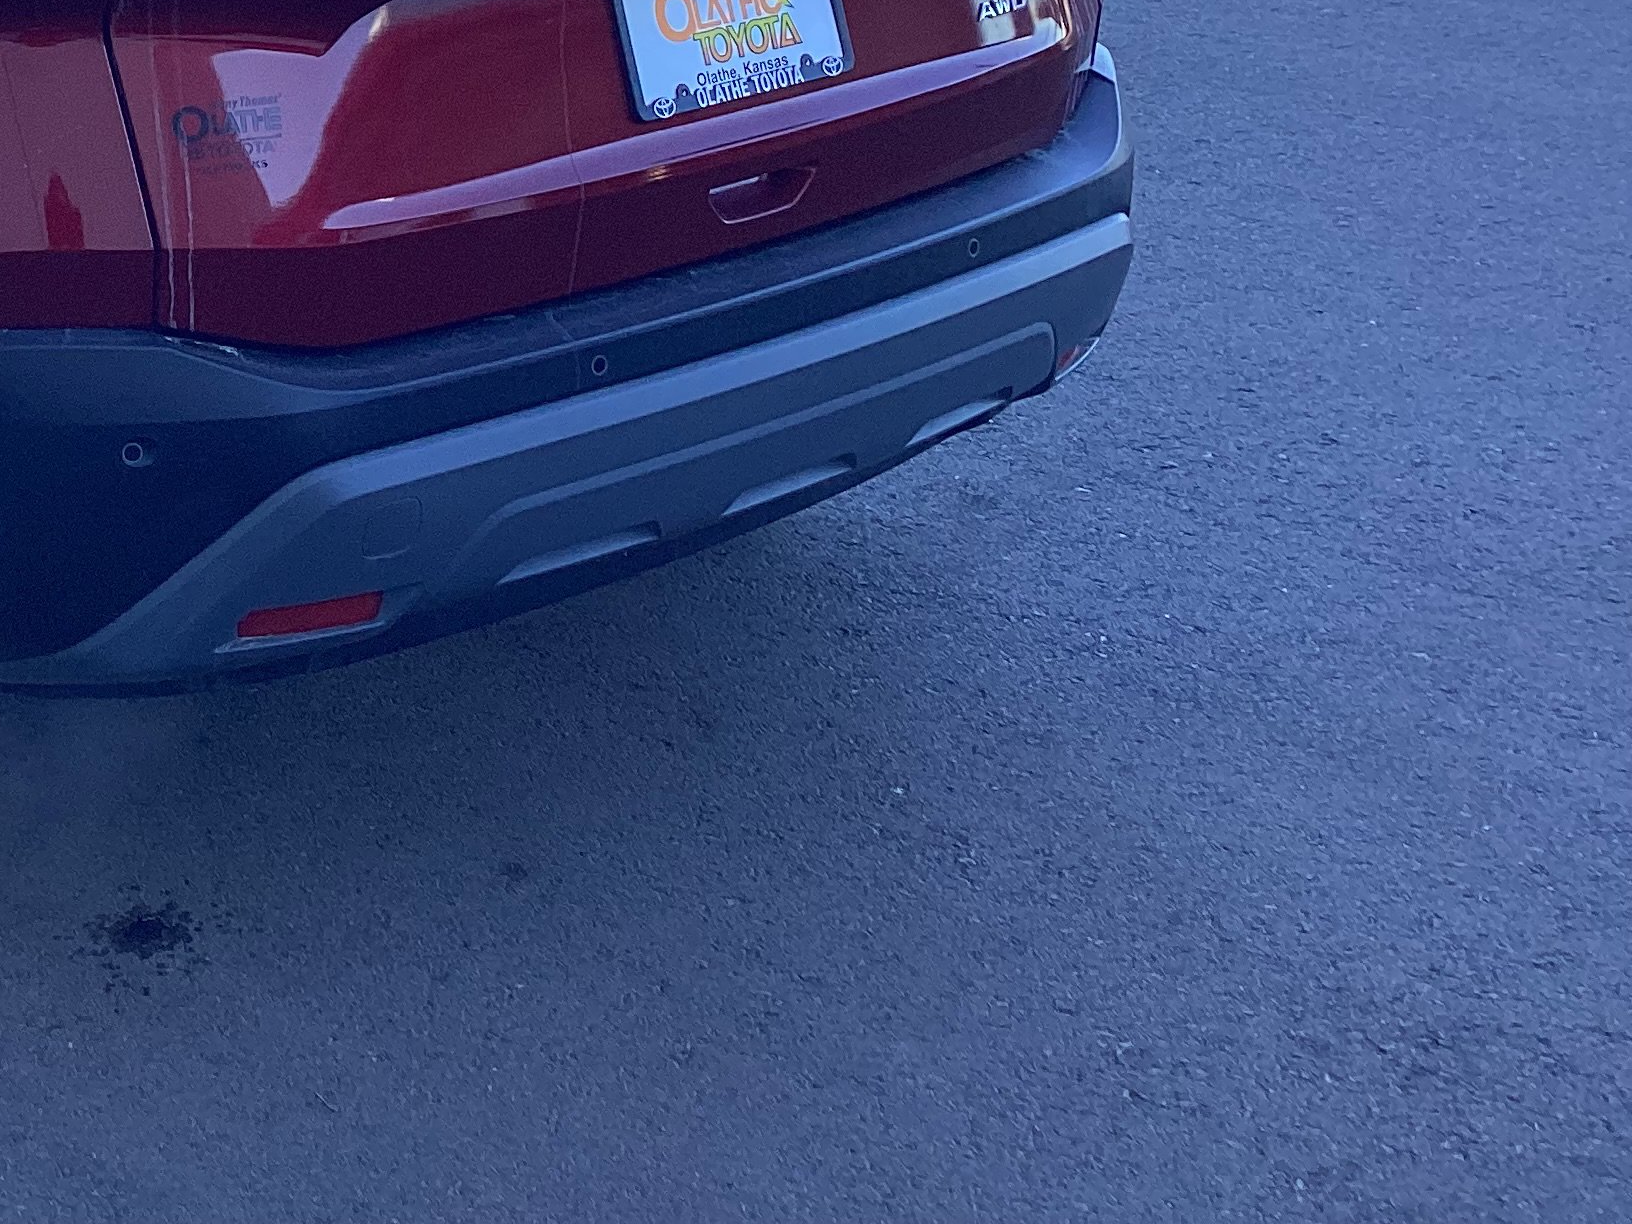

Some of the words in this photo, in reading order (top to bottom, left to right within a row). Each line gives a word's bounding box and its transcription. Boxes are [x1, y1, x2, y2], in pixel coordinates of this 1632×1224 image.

[693, 12, 803, 66] TOYOTA
[695, 79, 751, 108] OLATHE
[750, 66, 806, 95] TOYOTA
[696, 66, 741, 87] Olathe,
[743, 55, 789, 75] Kansas
